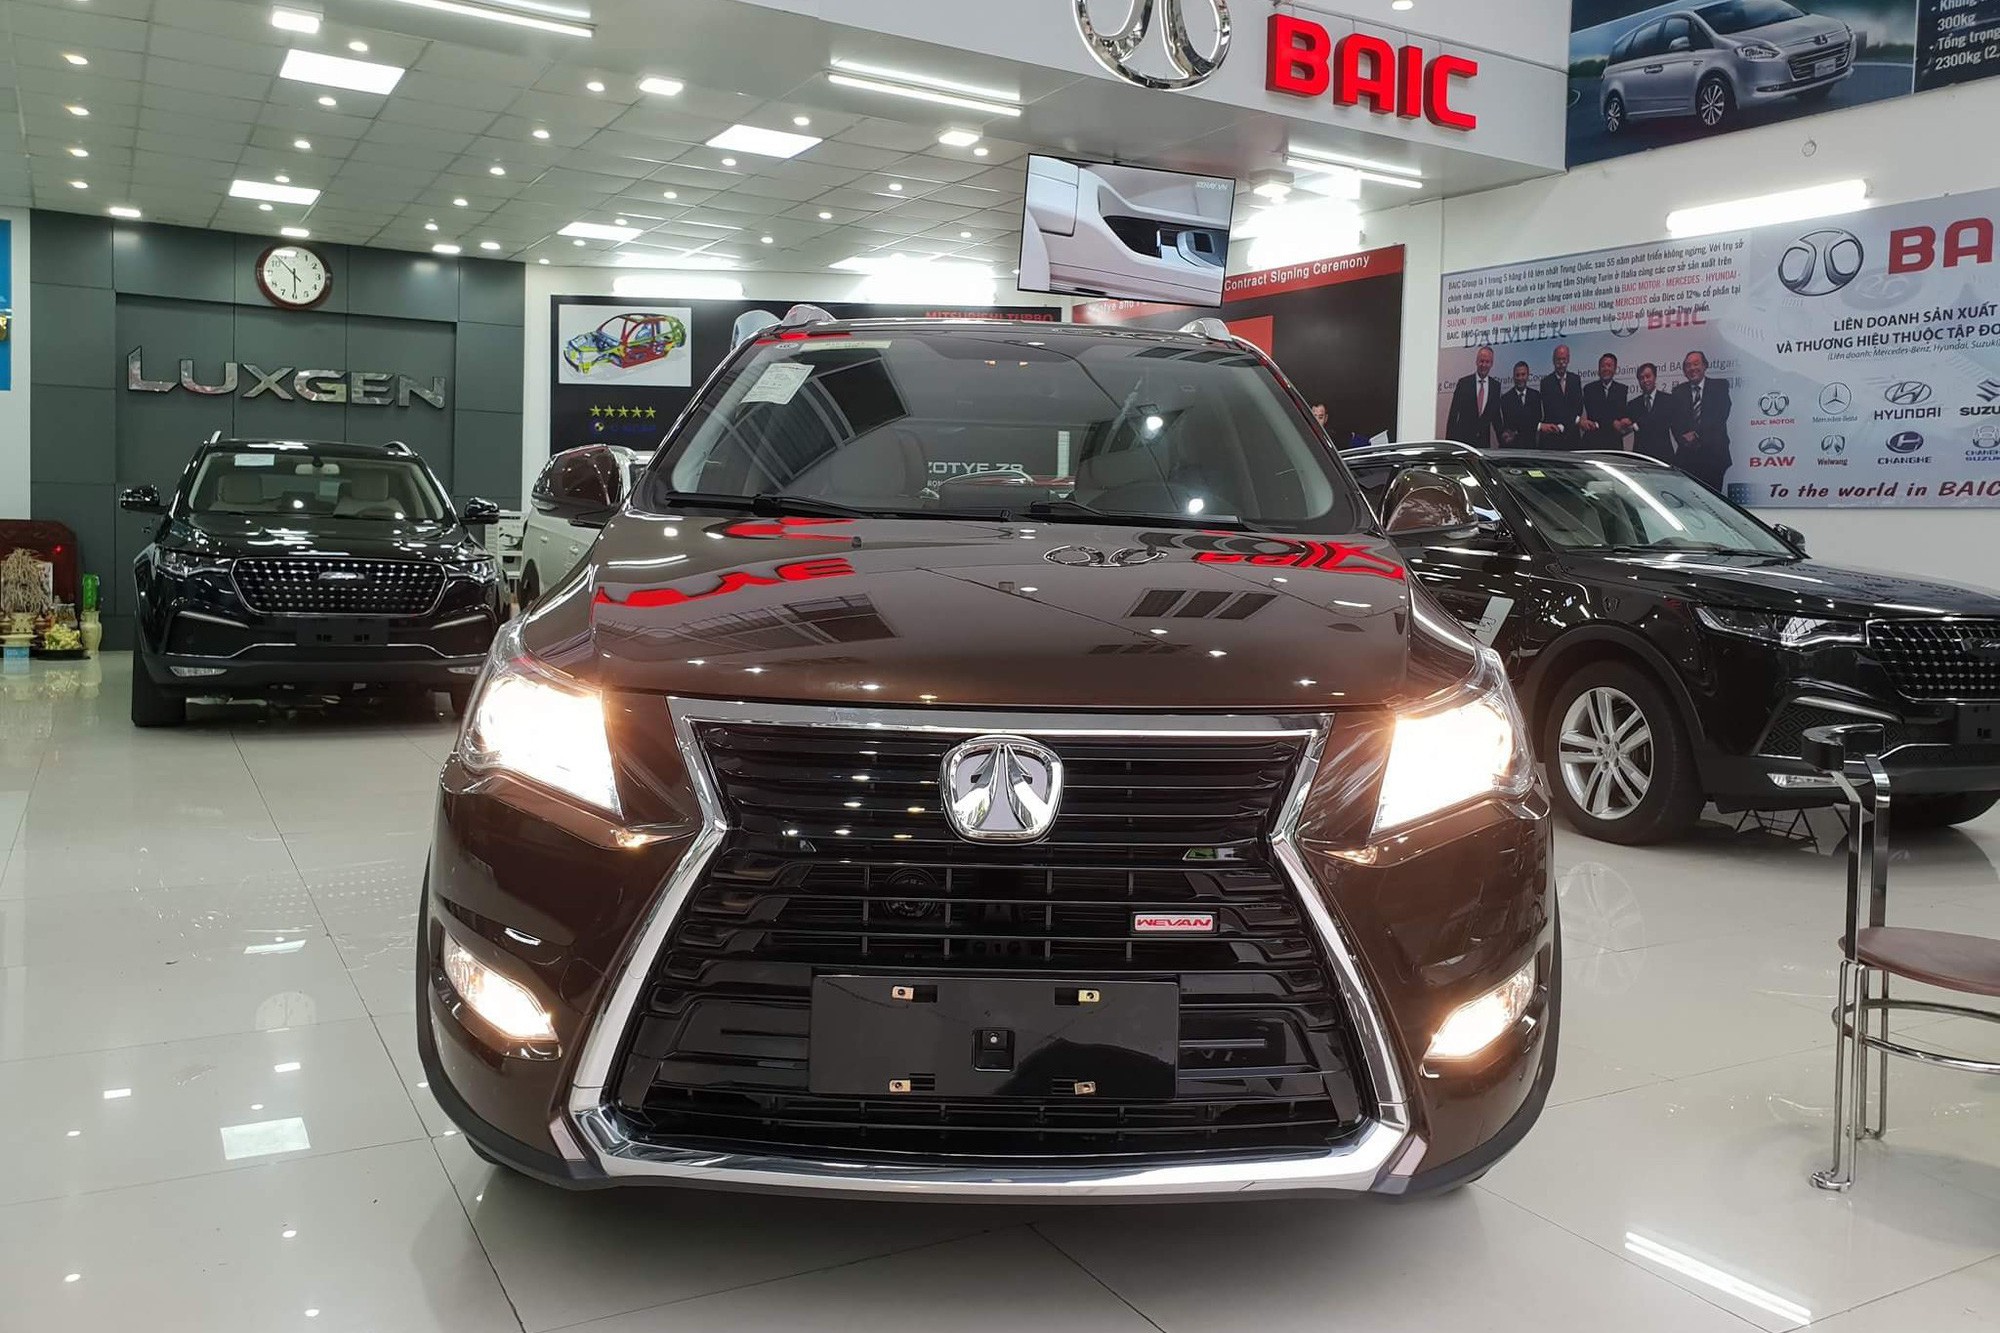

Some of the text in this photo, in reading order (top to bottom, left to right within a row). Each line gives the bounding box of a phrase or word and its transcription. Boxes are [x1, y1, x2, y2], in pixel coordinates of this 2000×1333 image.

[1937, 13, 1976, 31] 300kg
[1937, 27, 2000, 50] Tổng trọng
[1935, 51, 1981, 70] 2300kg
[1265, 13, 1478, 131] BAIC
[1559, 263, 1576, 274] Trung
[1663, 247, 1683, 260] không
[1224, 253, 1371, 291] Contract Signing Ceremony
[1576, 273, 1596, 285] Styling
[1621, 282, 1636, 291] BAIC
[1637, 279, 1660, 289] MOTOR
[1665, 274, 1700, 286] MERCEDES
[1705, 269, 1737, 281] HYUNDAI
[1614, 295, 1647, 306] MERCEDES
[1833, 301, 1998, 331] LIÊN DOANH SẢN XUẤT
[1776, 323, 2000, 354] VÀ THƯƠNG HIỆU THUỘC TẬP ĐO
[127, 346, 446, 409] LUXGEN
[1874, 407, 1942, 420] HYUNDAI
[1749, 456, 1796, 467] BAW
[1877, 456, 1932, 465] CHANGHE
[1769, 480, 2000, 498] To the world in BAIC
